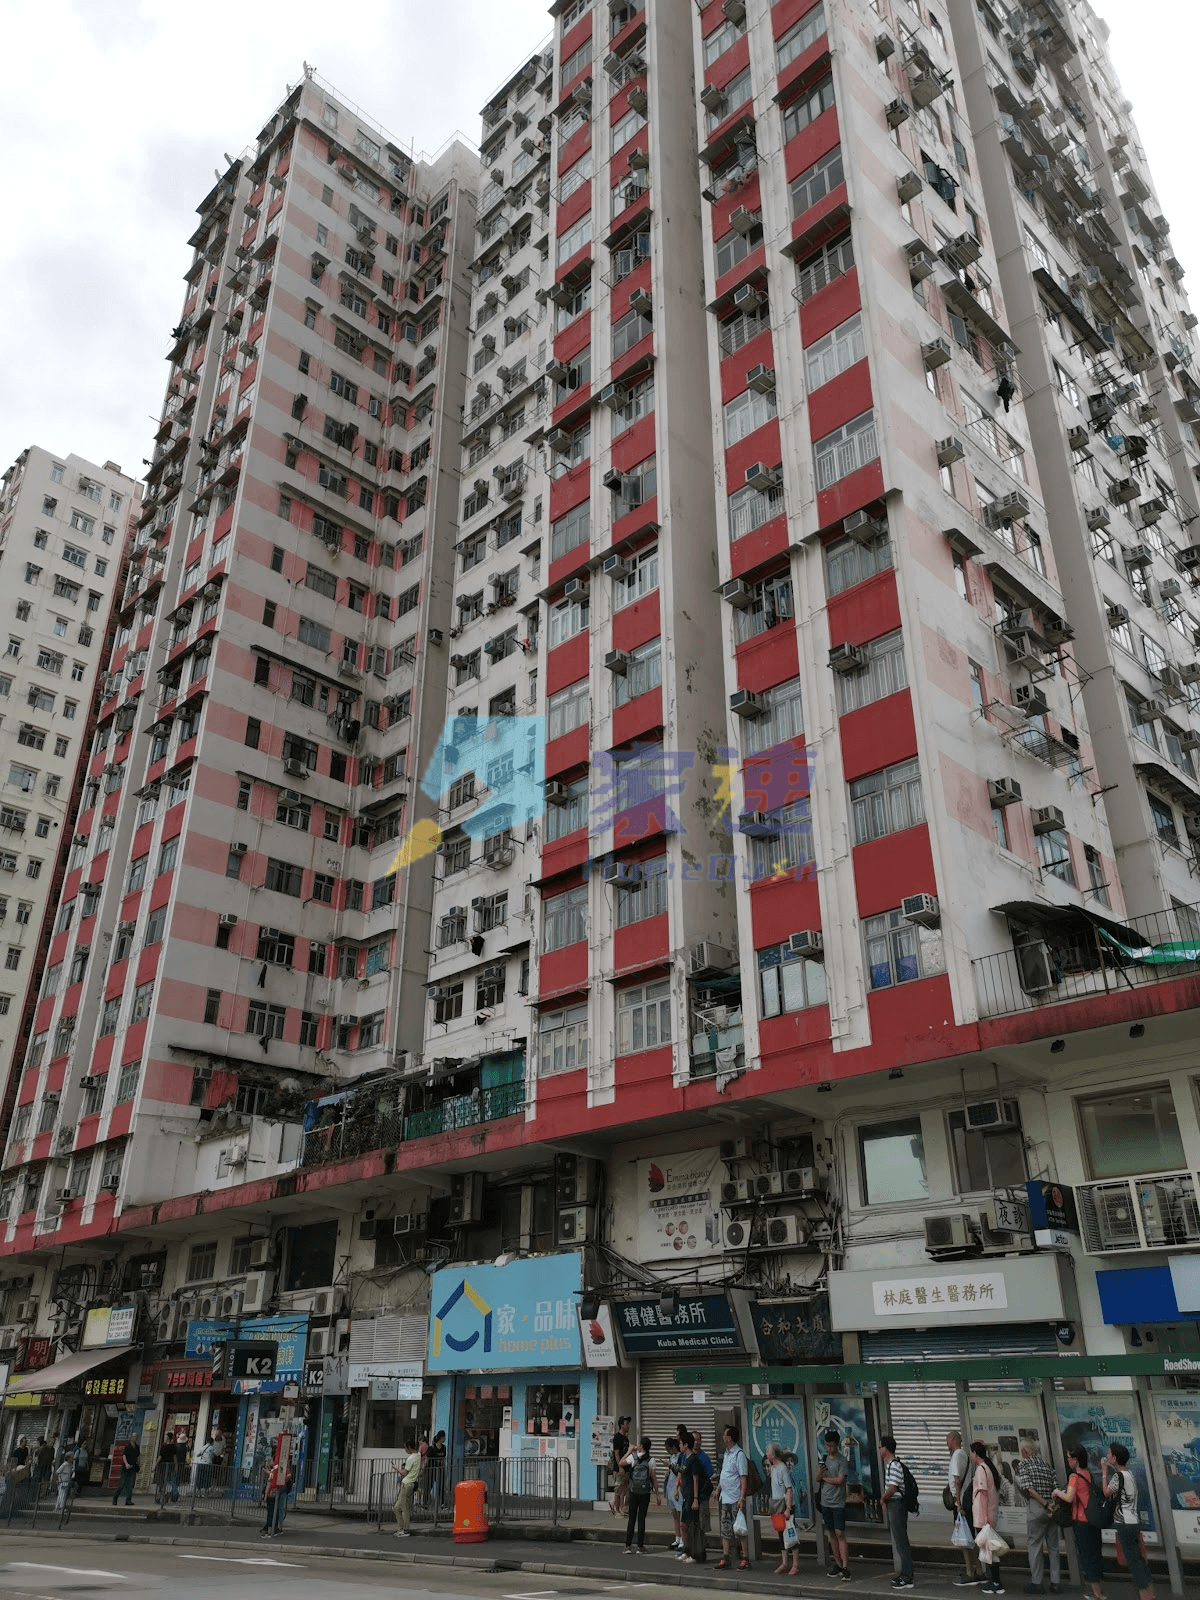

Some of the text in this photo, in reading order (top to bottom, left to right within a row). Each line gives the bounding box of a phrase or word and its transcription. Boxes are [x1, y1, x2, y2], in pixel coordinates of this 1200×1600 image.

[666, 1168, 689, 1182] Emma
[999, 1200, 1024, 1229] 夜診
[883, 1283, 995, 1307] 林庭醫生醫務所
[34, 1340, 48, 1355] 明
[498, 1335, 571, 1354] home plus
[657, 1336, 734, 1348] Kuba Medical Clinic
[228, 1348, 236, 1377] SALON
[246, 1357, 273, 1375] K2
[309, 1370, 323, 1385] K2
